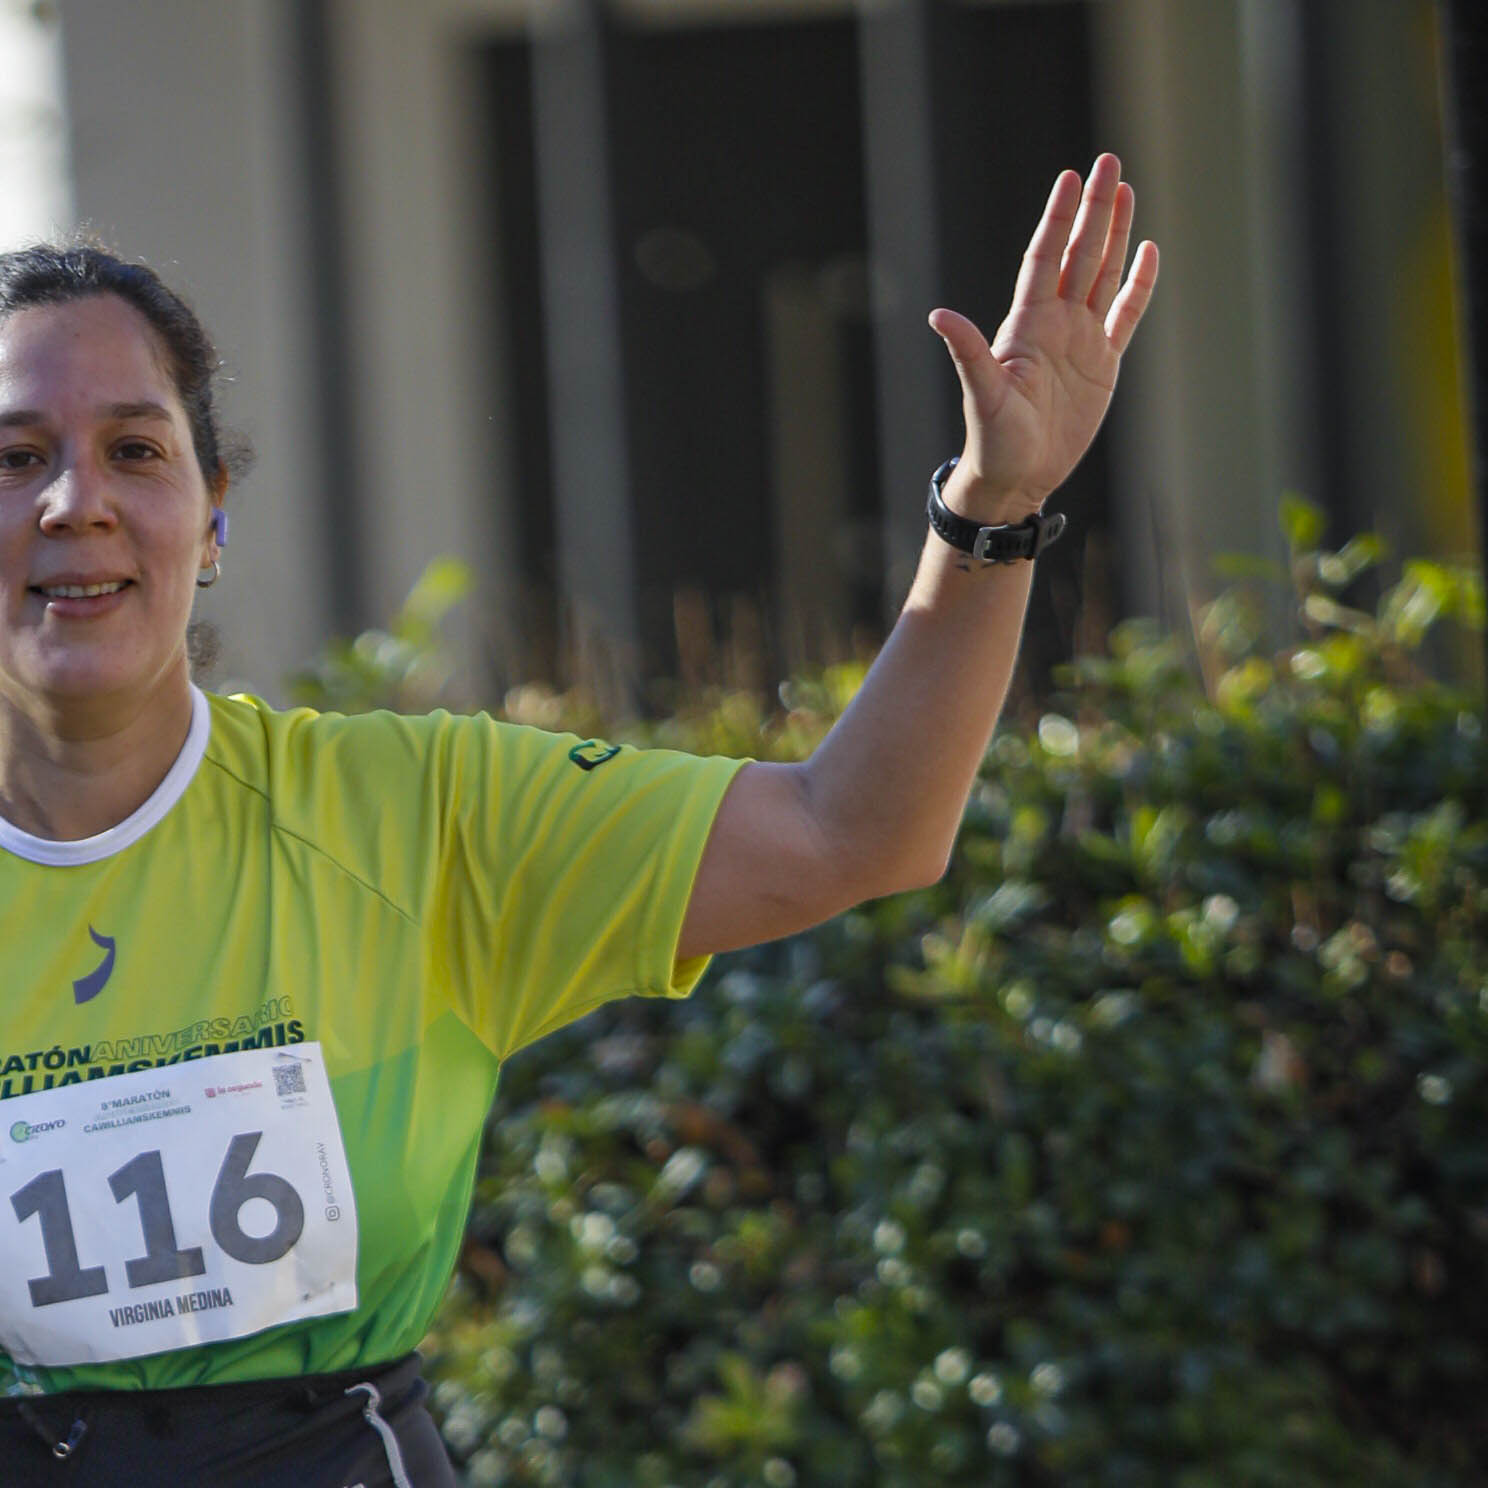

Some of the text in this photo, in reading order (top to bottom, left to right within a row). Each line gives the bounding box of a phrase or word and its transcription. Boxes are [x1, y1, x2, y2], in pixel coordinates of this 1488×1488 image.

[9, 1130, 305, 1308] 116
[108, 1287, 234, 1328] VIRGINIA MEDINA
